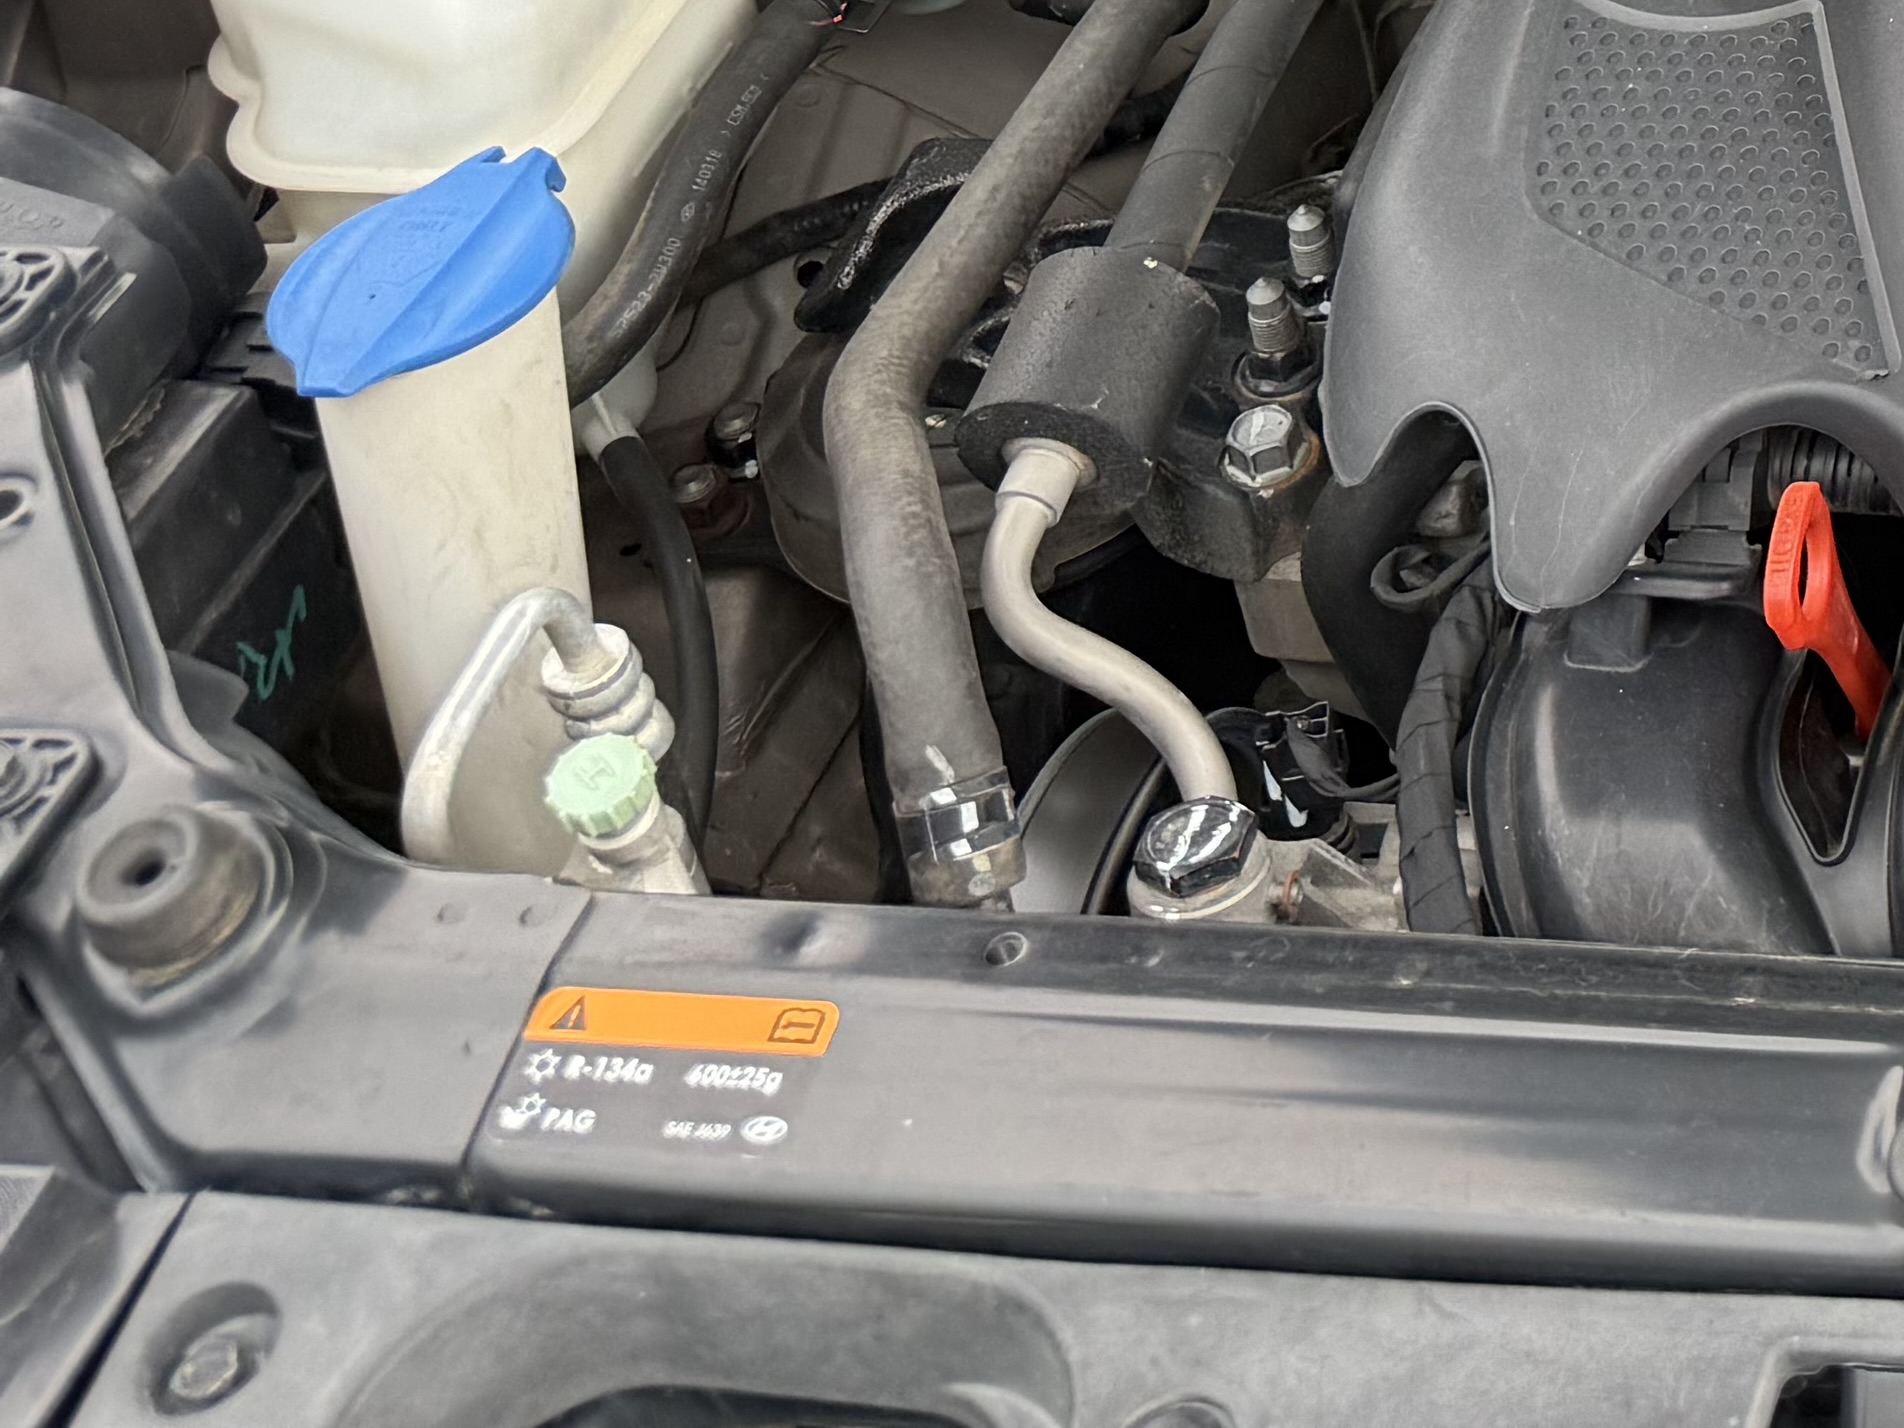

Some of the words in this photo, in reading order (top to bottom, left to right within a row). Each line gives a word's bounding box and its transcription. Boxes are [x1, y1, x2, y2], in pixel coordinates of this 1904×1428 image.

[562, 1055, 654, 1085] R-134a
[684, 1063, 784, 1095] 600±25g
[540, 1107, 597, 1133] PAG
[663, 1119, 695, 1139] SAE
